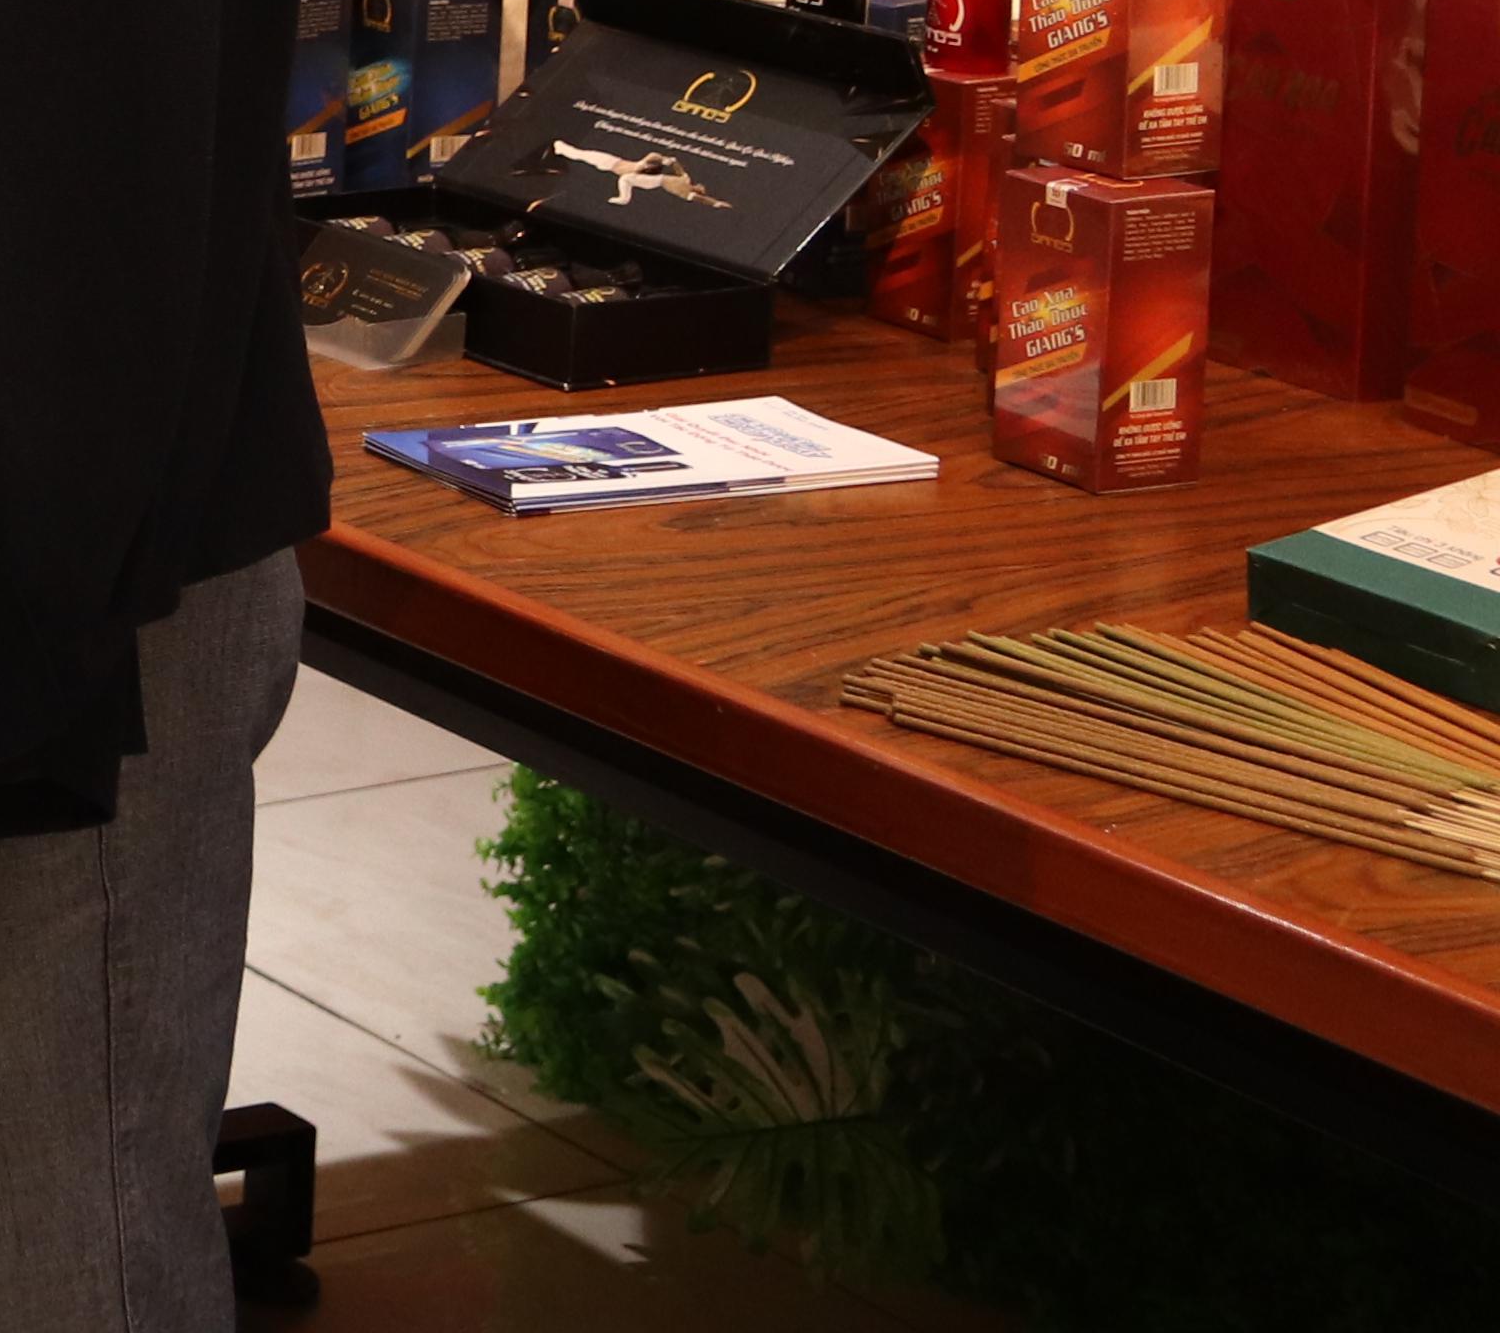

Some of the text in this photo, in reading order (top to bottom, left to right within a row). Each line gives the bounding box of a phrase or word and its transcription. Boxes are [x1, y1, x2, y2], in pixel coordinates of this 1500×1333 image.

[1047, 10, 1109, 49] GIANG'S
[1011, 298, 1039, 318] Cao
[1026, 324, 1085, 357] GIANG'S
